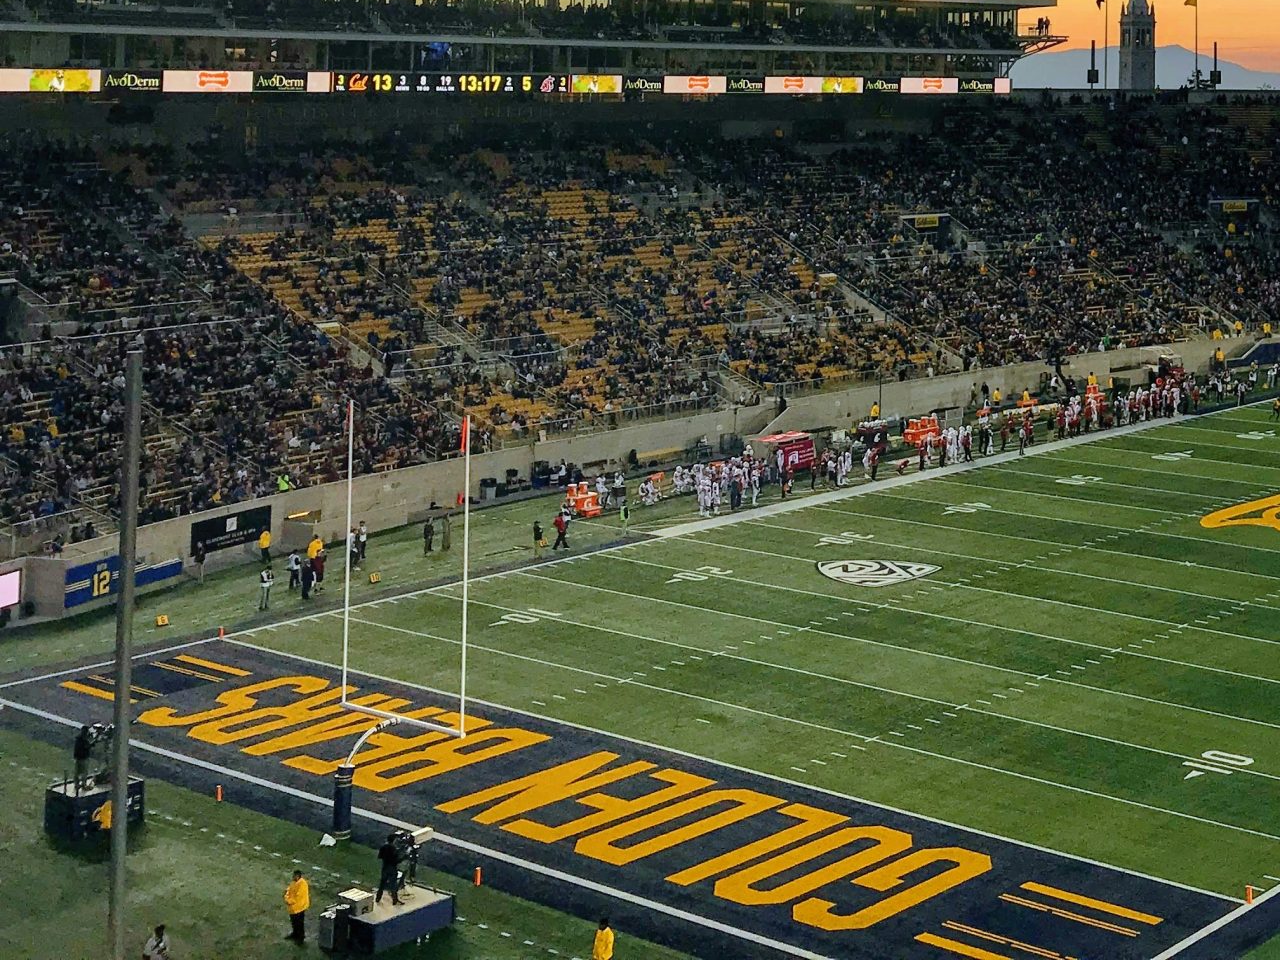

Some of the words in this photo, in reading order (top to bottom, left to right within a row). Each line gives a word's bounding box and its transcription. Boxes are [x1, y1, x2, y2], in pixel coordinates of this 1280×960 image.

[338, 74, 344, 84] 3
[349, 73, 369, 91] Cal
[373, 74, 392, 91] 13
[400, 75, 406, 85] 3
[420, 75, 427, 85] 8
[440, 75, 452, 86] 19
[459, 75, 501, 92] 13:17
[506, 76, 512, 86] 2
[522, 76, 532, 91] 5
[560, 77, 566, 86] 3
[92, 570, 111, 597] 12
[500, 608, 563, 624] 10
[137, 675, 552, 792] BEARS
[1182, 750, 1255, 775] 10
[434, 751, 993, 932] GOLDEN
